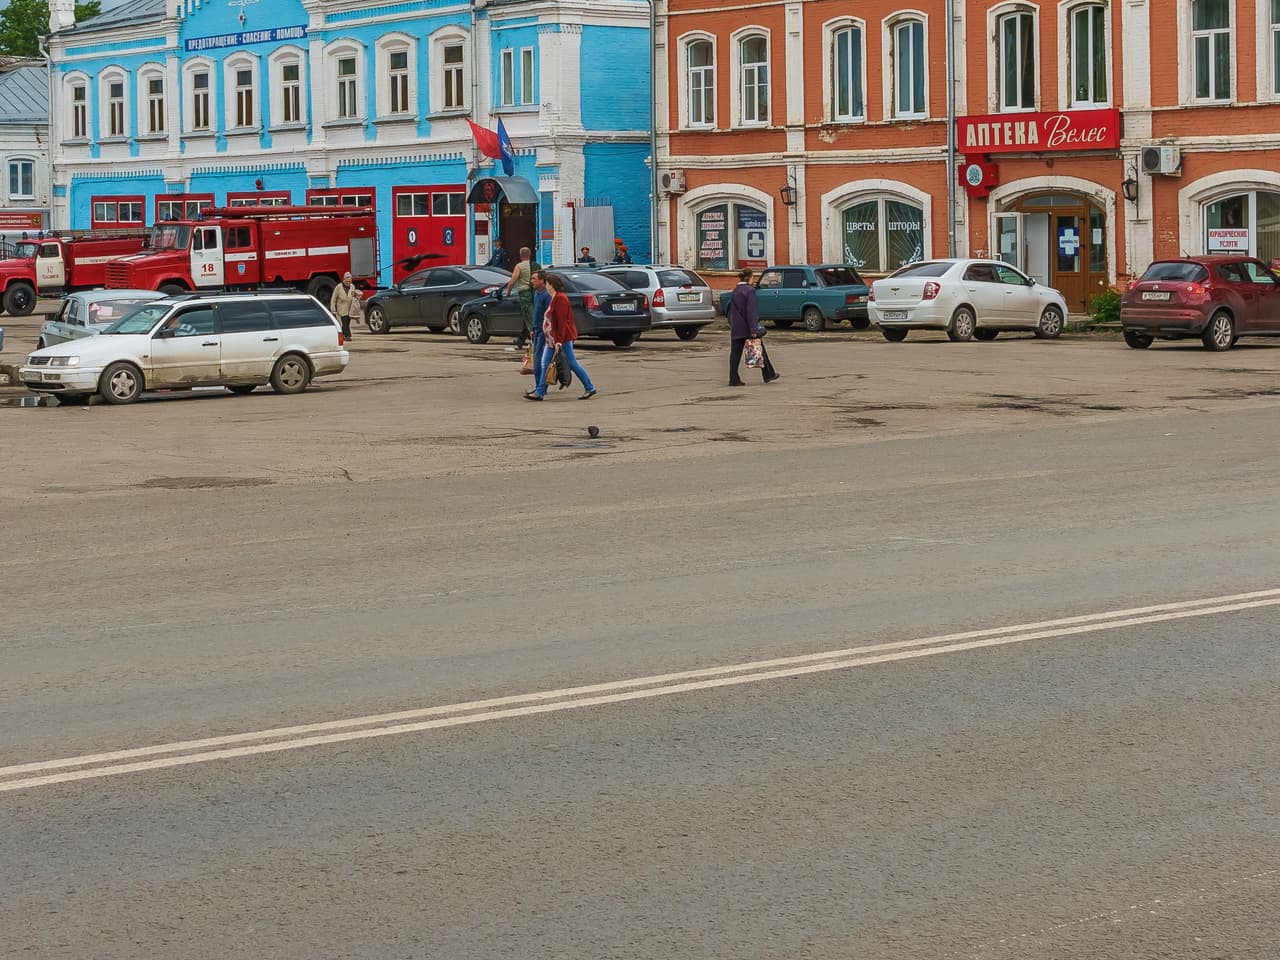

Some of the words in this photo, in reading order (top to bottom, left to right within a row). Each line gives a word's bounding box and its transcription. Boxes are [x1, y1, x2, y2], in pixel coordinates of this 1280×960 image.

[188, 35, 238, 50] ПРЕДОТВРАЩЕНИЕ
[242, 29, 271, 44] СПАСЕНИЕ
[276, 26, 304, 40] ПОМОЩЬ
[966, 120, 1039, 147] АПТЕКА
[1043, 114, 1107, 148] Велес
[846, 222, 875, 233] цветы
[888, 222, 920, 234] шторы
[1209, 230, 1247, 238] ЮРИДИЧЕСКИЕ
[1219, 240, 1238, 248] УСЛУГИ
[201, 263, 215, 273] 18
